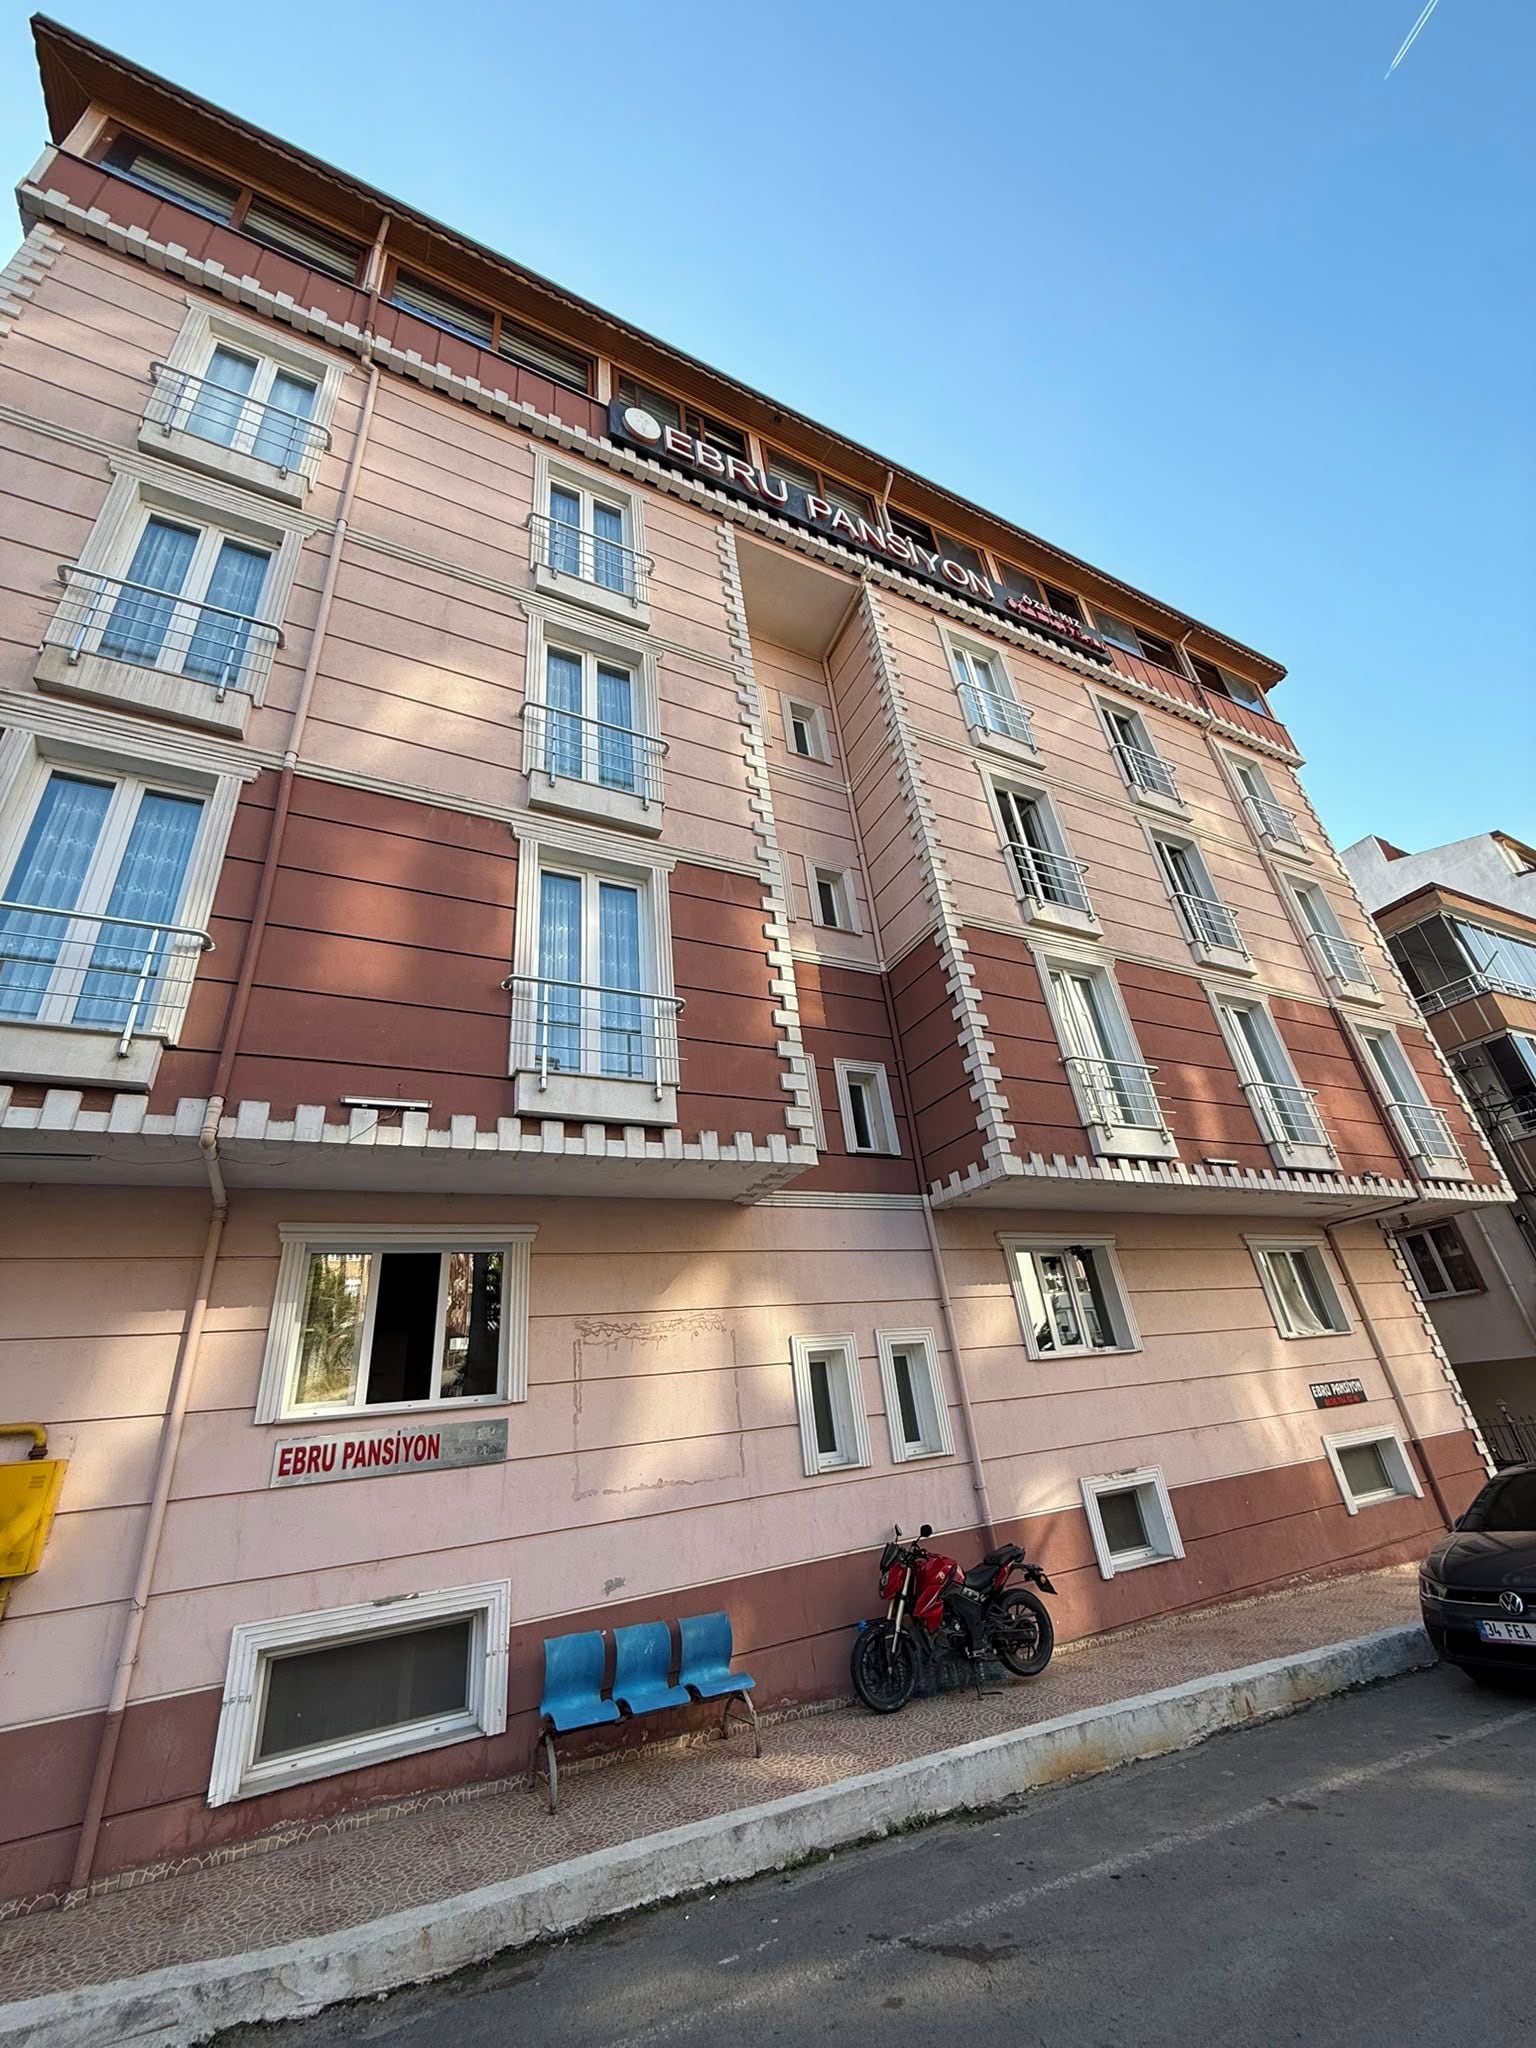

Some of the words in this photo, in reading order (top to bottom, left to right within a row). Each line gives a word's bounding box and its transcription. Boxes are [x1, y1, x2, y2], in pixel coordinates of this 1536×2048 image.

[664, 425, 788, 506] EBRU
[805, 493, 995, 600] PANSİYON
[1311, 1385, 1332, 1397] EBRU
[278, 1442, 337, 1477] EBRU
[341, 1430, 440, 1469] PANSİYON
[1484, 1622, 1502, 1637] 34
[1504, 1624, 1532, 1639] FEA
